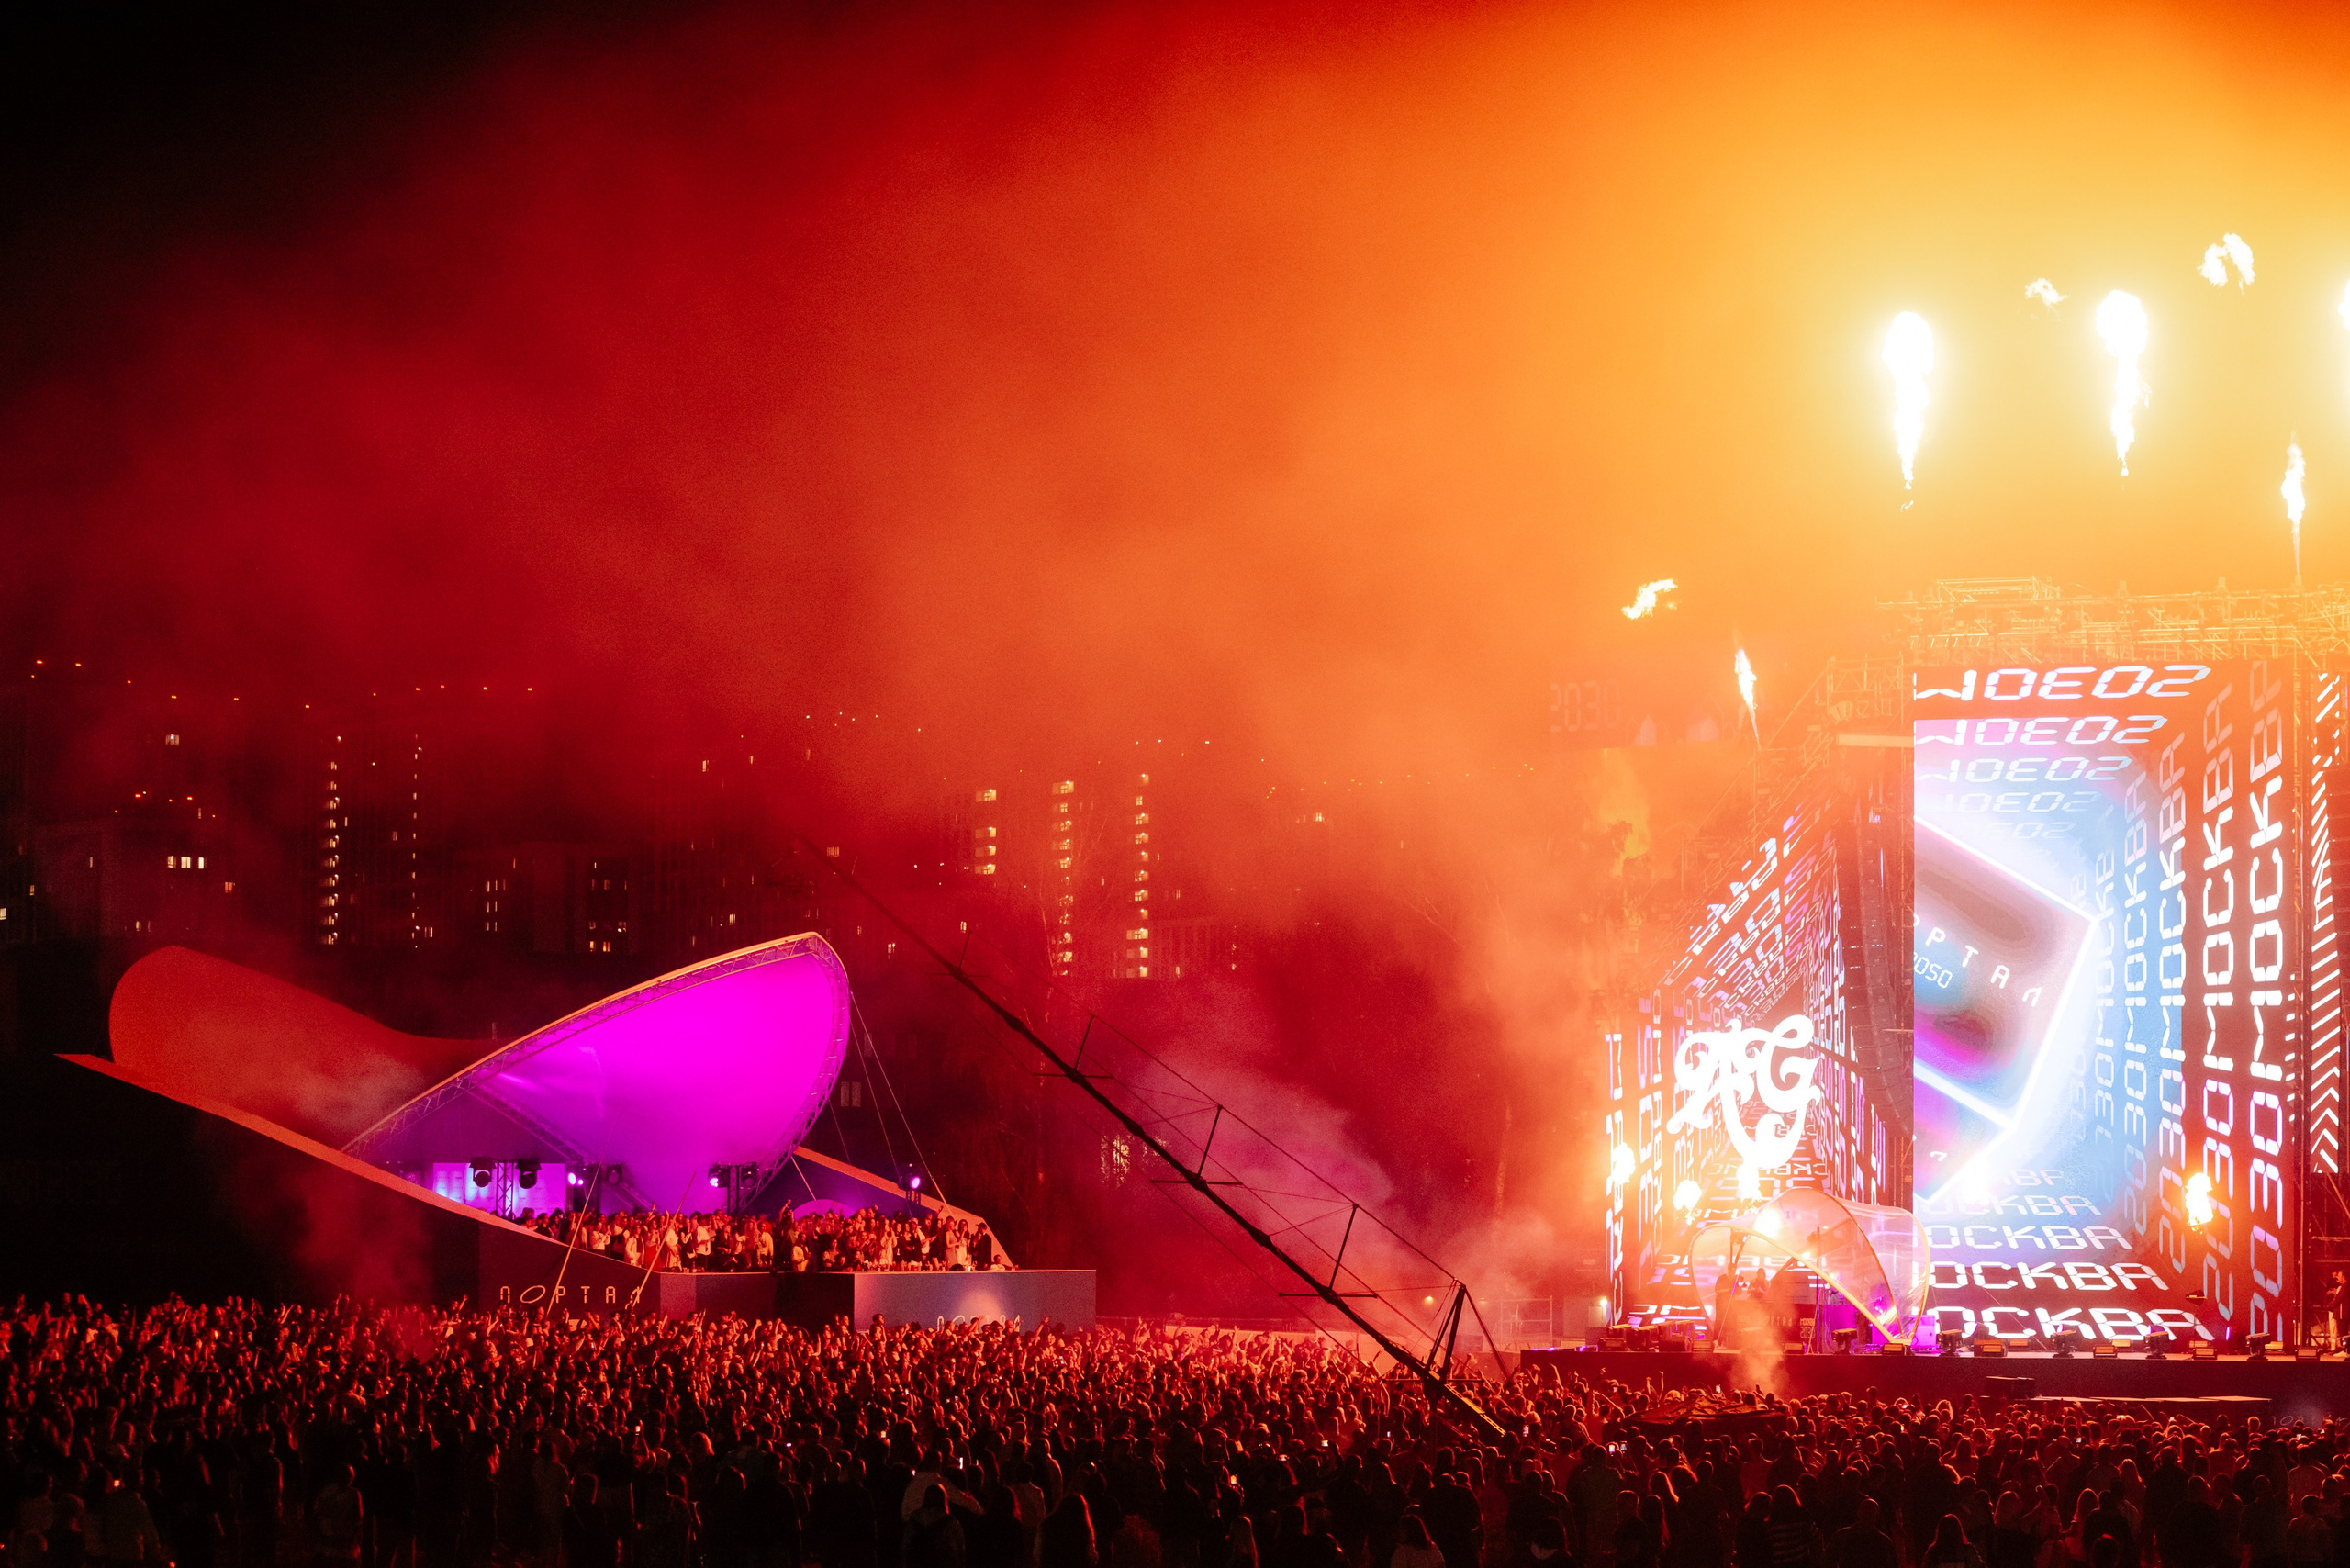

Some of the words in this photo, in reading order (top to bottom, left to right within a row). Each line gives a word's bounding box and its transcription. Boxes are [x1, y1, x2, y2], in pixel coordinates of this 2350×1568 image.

[1914, 913, 2042, 1007] РТАЛ
[1914, 1195, 2102, 1216] ОСКВА
[1913, 1225, 2132, 1250] ОСКВА
[1912, 1260, 2170, 1291] ОСКВА
[1912, 1305, 2215, 1341] ОСКВА
